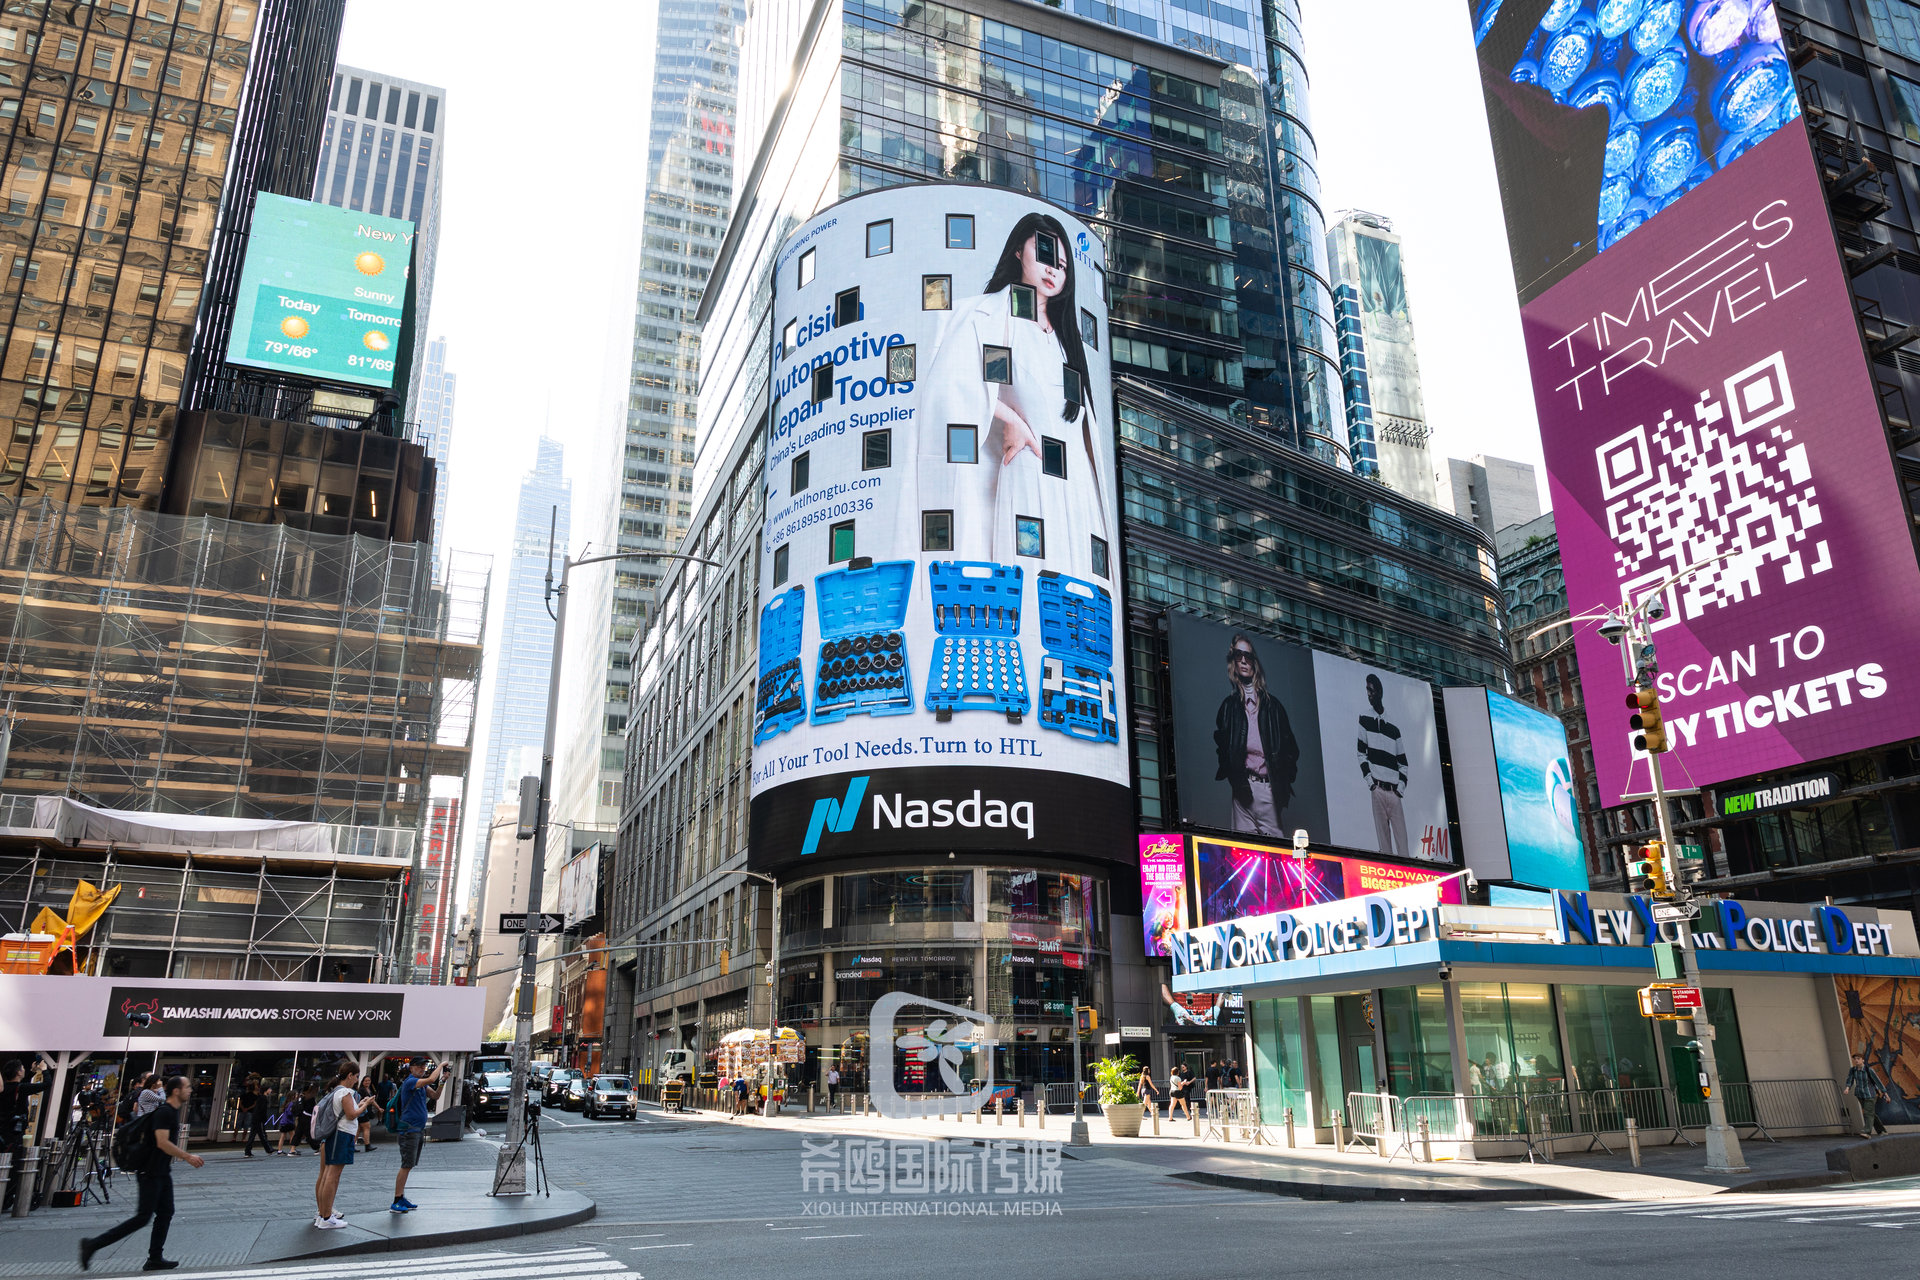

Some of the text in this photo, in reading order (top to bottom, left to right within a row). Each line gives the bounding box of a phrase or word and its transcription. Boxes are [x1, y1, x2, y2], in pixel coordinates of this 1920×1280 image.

[358, 224, 396, 242] New
[811, 218, 838, 238] POWER
[1074, 247, 1094, 271] HTL
[354, 286, 395, 305] Sunny
[1548, 199, 1794, 368] TIMES
[277, 295, 321, 315] Today
[264, 340, 319, 359] 79°/66°
[774, 302, 865, 371] Pcisi
[1555, 261, 1808, 411] TRAVEL
[774, 331, 905, 400] Automotive
[771, 400, 823, 447] epai
[770, 406, 916, 471] China's Leading Supplier
[773, 476, 881, 525] www.htlhongtu.com
[772, 497, 874, 544] +86 8618958100336
[1656, 624, 1825, 704] SCAN TO
[1706, 662, 1888, 740] TICKETS
[762, 760, 775, 780] All
[779, 755, 809, 773] Your
[812, 742, 849, 764] Tool
[973, 738, 992, 754] to
[1000, 737, 1043, 758] HTL
[873, 790, 1035, 840] Nasdaq
[1420, 825, 1449, 860] H&M
[1686, 846, 1691, 857] 7
[1361, 876, 1403, 890] BIGGEST
[506, 918, 552, 928] ONE AY
[1657, 906, 1693, 917] ONE WAY
[860, 956, 882, 964] Nasdaq
[1012, 956, 1035, 964] Nasdaq
[162, 1007, 221, 1019] TAMASHII
[282, 1008, 322, 1021] STORE
[326, 1009, 356, 1021] NEW
[358, 1009, 391, 1021] YORK
